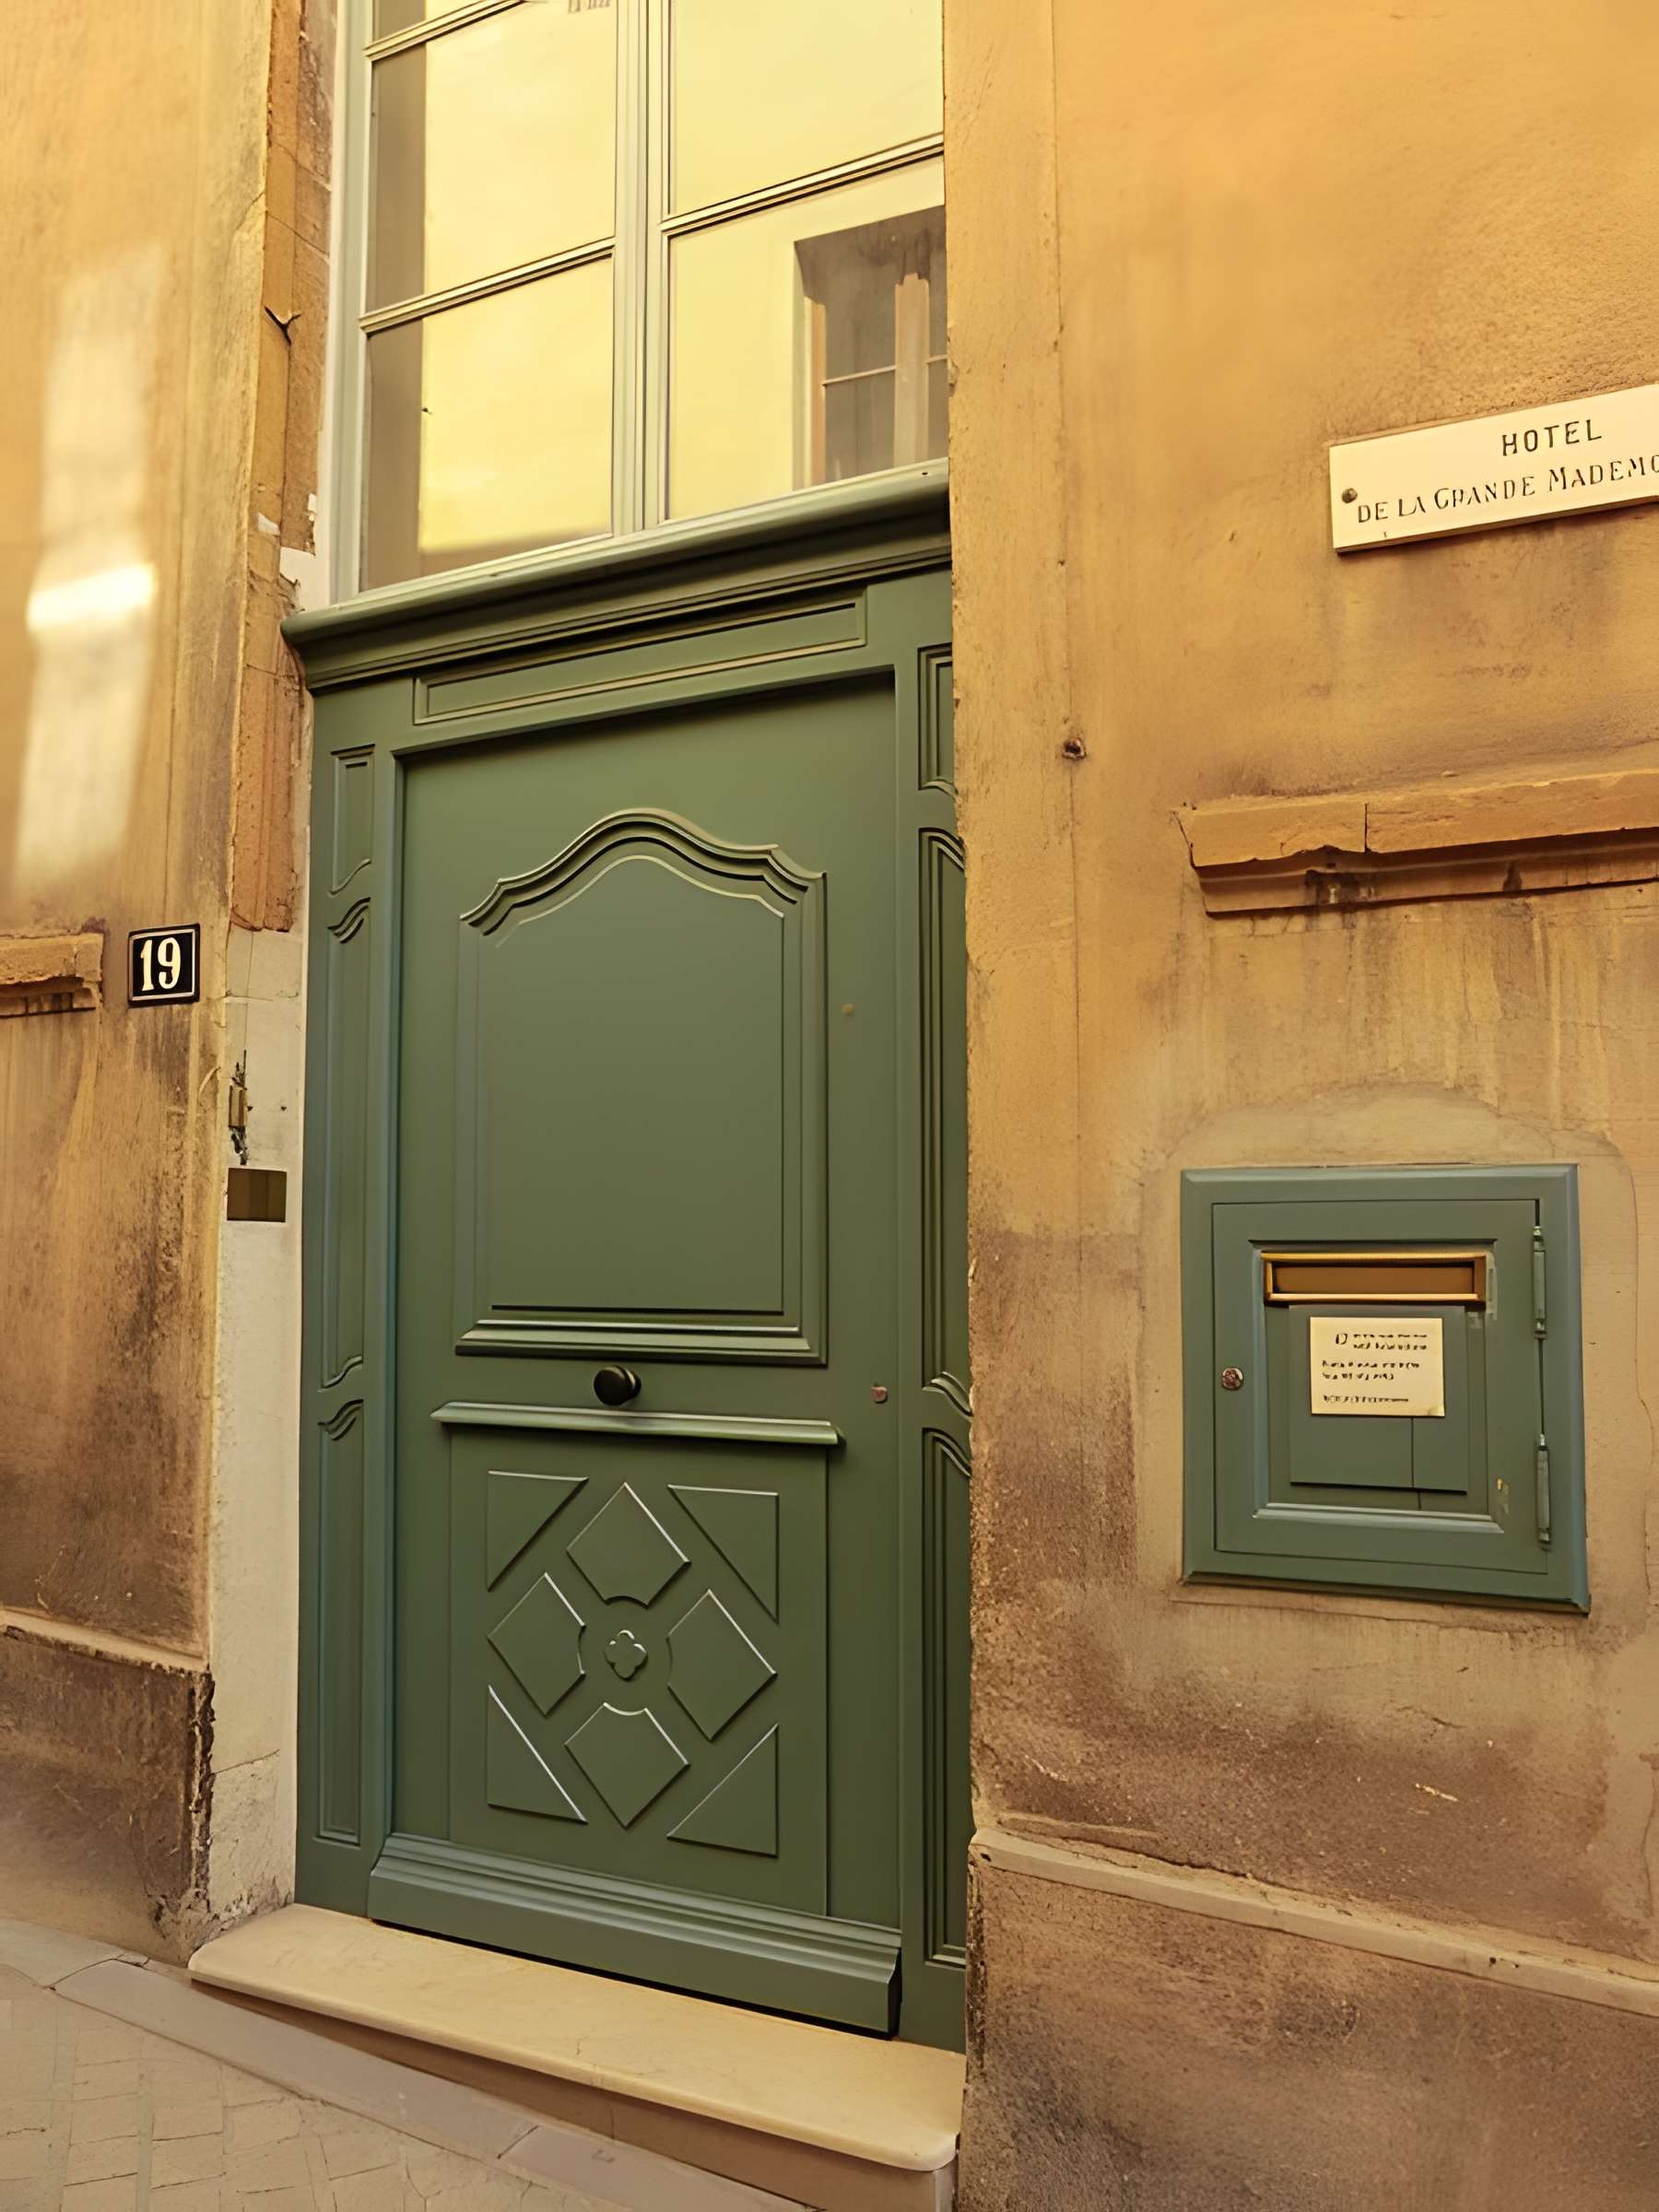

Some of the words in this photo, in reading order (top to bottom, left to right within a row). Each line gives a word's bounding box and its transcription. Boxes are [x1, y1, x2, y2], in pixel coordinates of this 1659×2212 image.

[1501, 419, 1603, 456] HOTEL
[1358, 501, 1389, 524] DE
[1398, 496, 1427, 518] LA
[1434, 476, 1536, 511] GRANDE
[139, 936, 182, 992] 19
